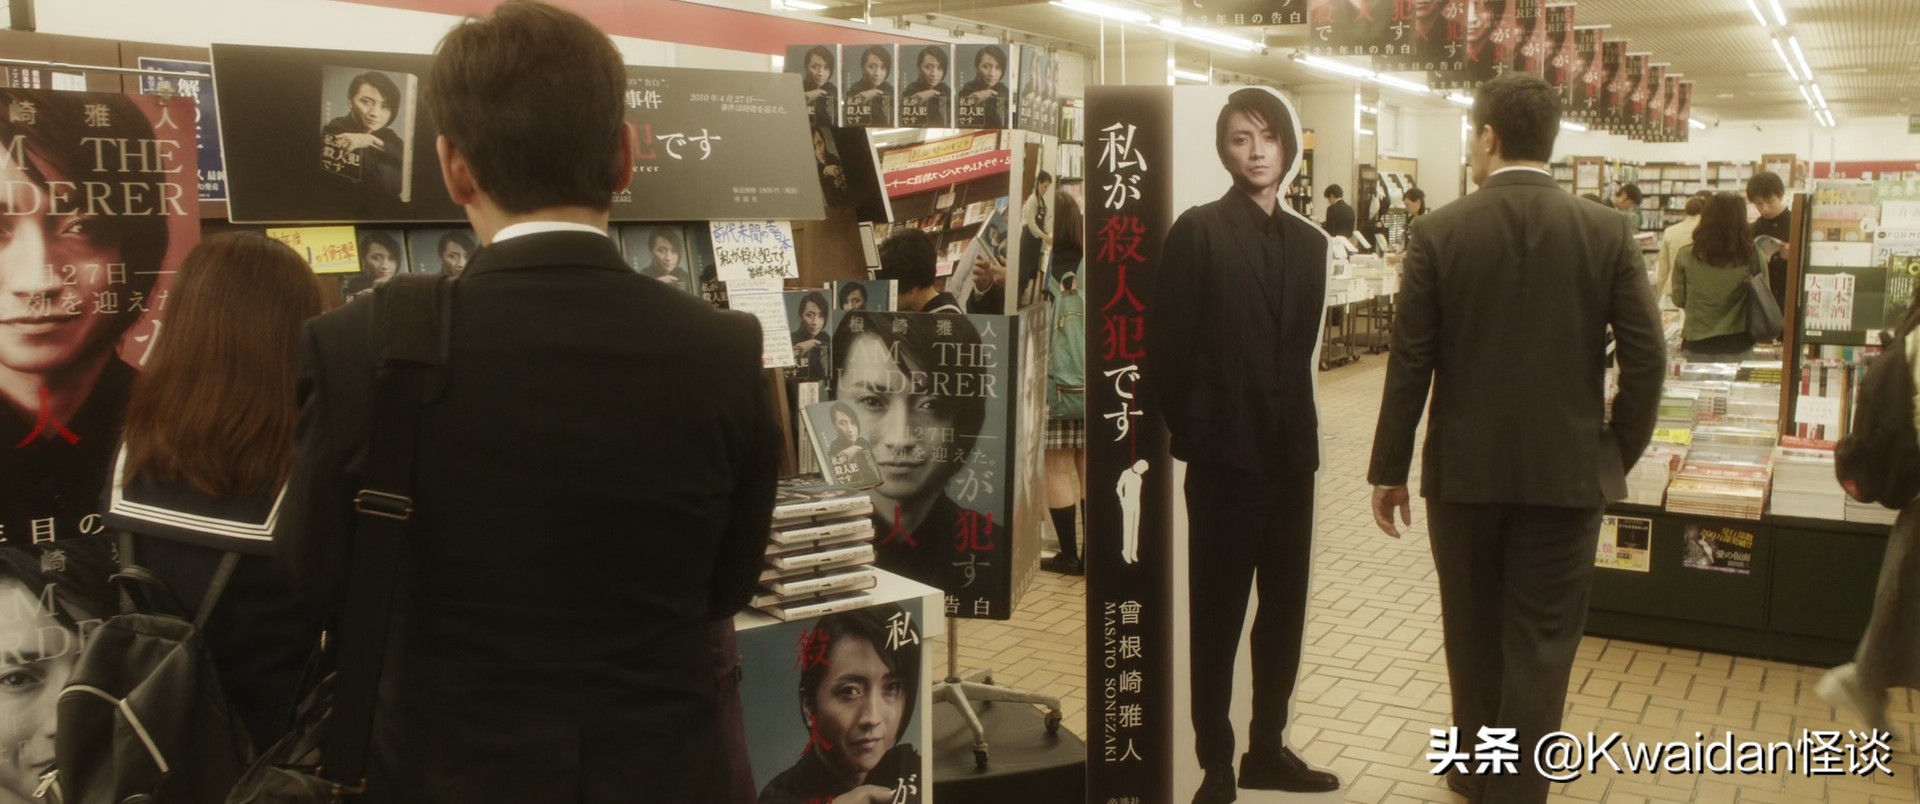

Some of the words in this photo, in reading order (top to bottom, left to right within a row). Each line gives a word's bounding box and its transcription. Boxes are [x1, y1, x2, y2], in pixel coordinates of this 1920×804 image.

[80, 136, 184, 174] THE
[1097, 121, 1148, 442] 私が殺人犯です
[931, 341, 998, 368] THE
[825, 367, 1000, 399] URDERER
[1104, 601, 1117, 669] MASATO
[1104, 677, 1117, 762] SONEZAKI
